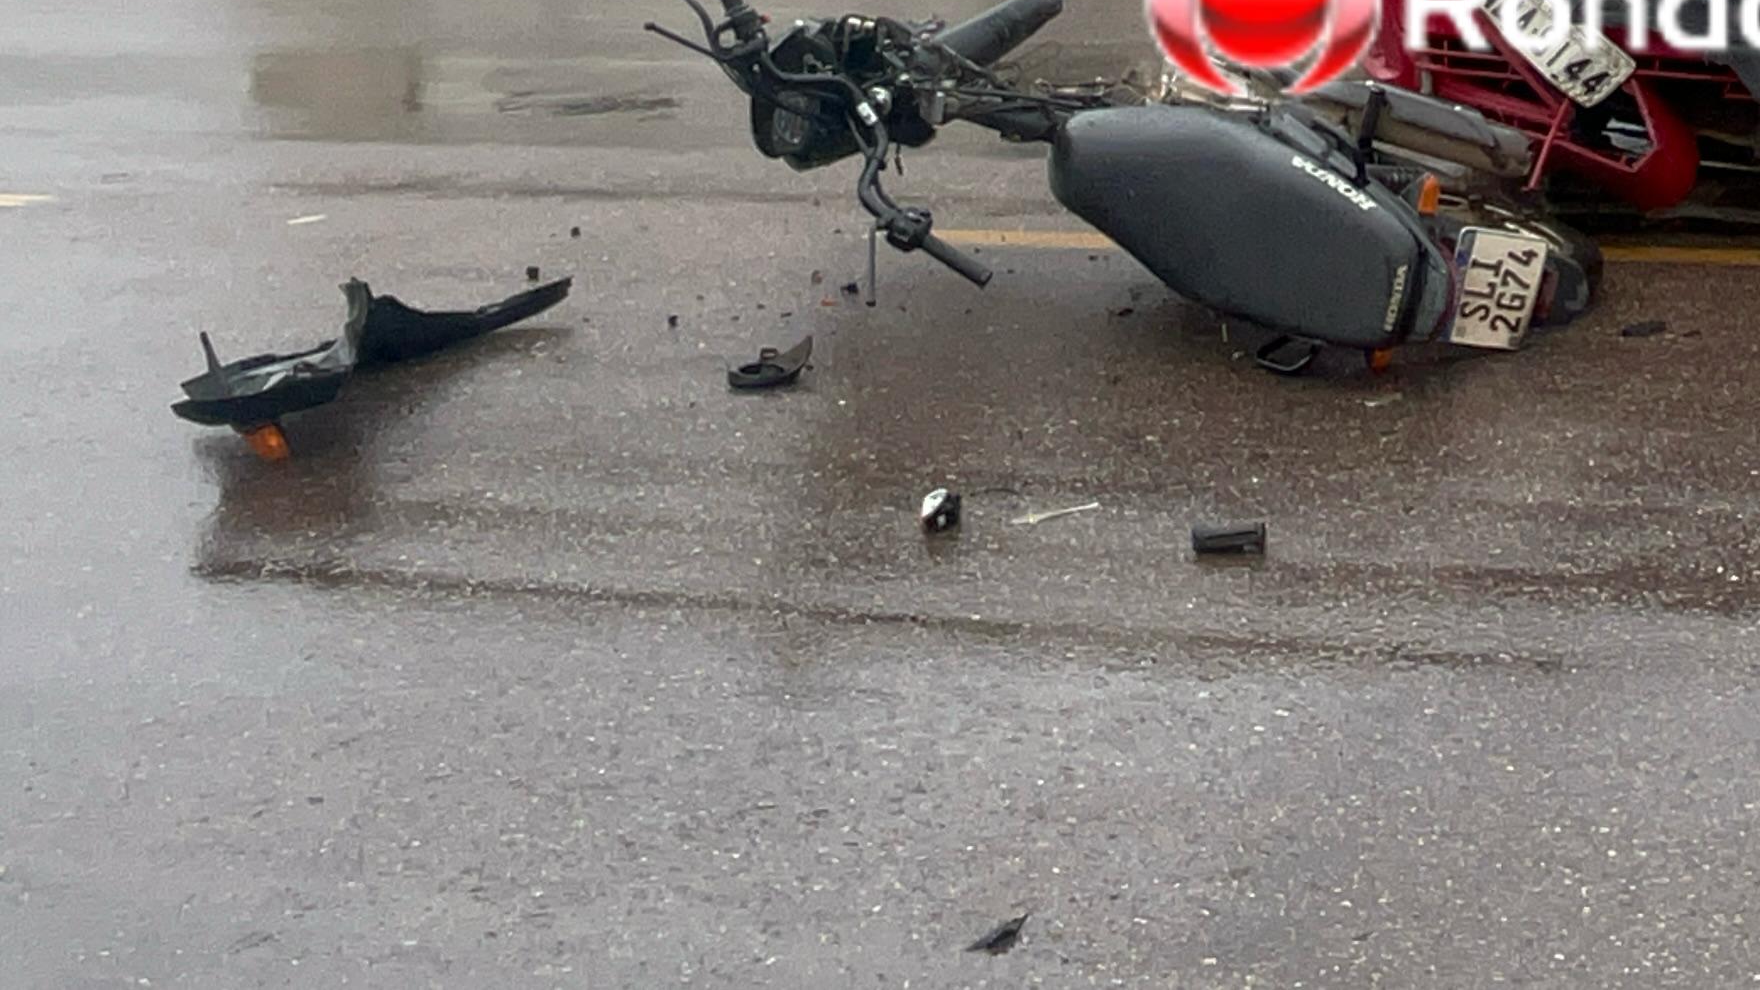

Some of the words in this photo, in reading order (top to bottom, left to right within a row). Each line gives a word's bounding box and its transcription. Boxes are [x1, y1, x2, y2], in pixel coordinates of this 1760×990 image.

[1290, 155, 1378, 211] HONDA
[1460, 257, 1500, 322] SLI
[1489, 247, 1540, 335] 2G74
